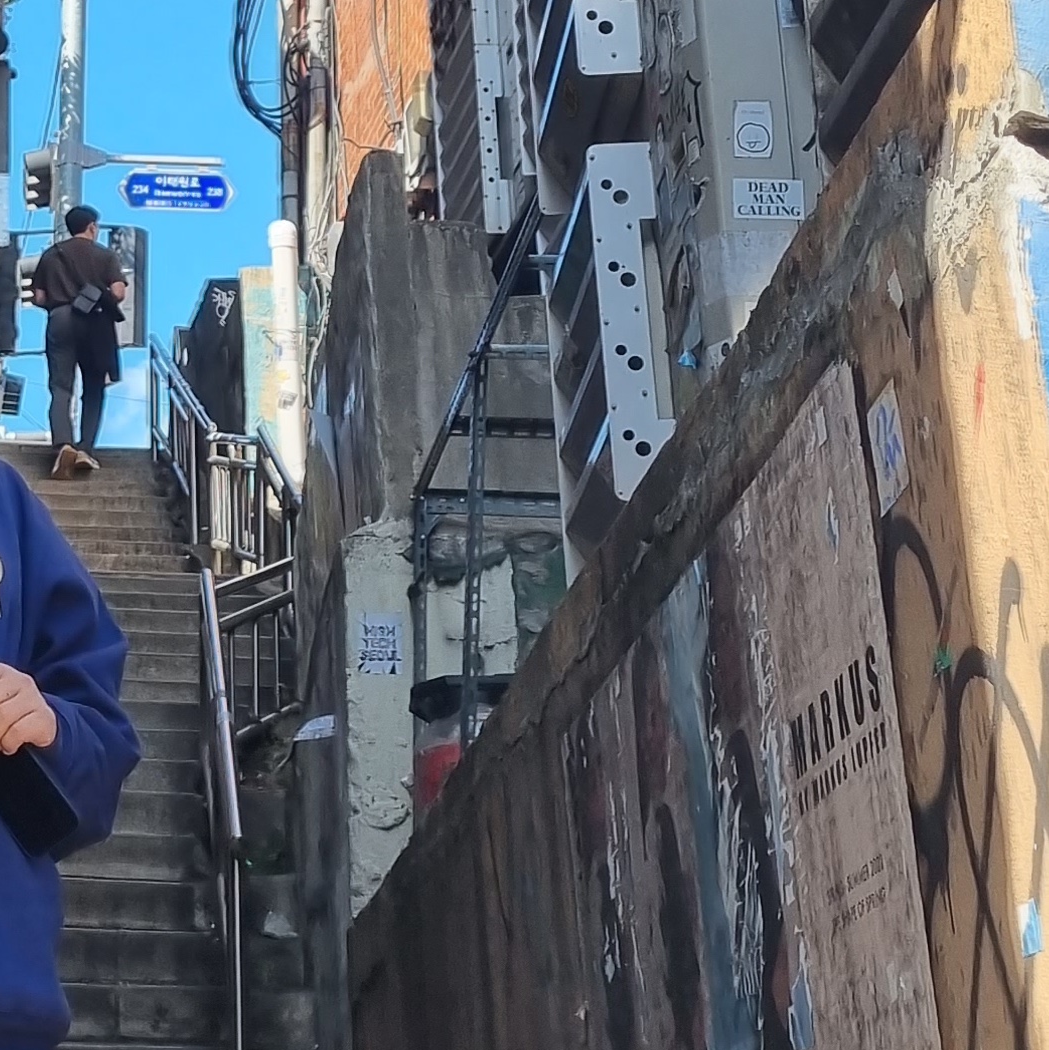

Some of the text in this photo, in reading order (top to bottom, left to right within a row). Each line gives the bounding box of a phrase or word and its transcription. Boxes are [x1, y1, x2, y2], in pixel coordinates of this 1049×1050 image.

[131, 184, 150, 195] 234
[748, 182, 789, 193] DEAD
[752, 194, 786, 204] MAN
[737, 205, 801, 217] CALLING
[791, 645, 881, 780] MARKUS
